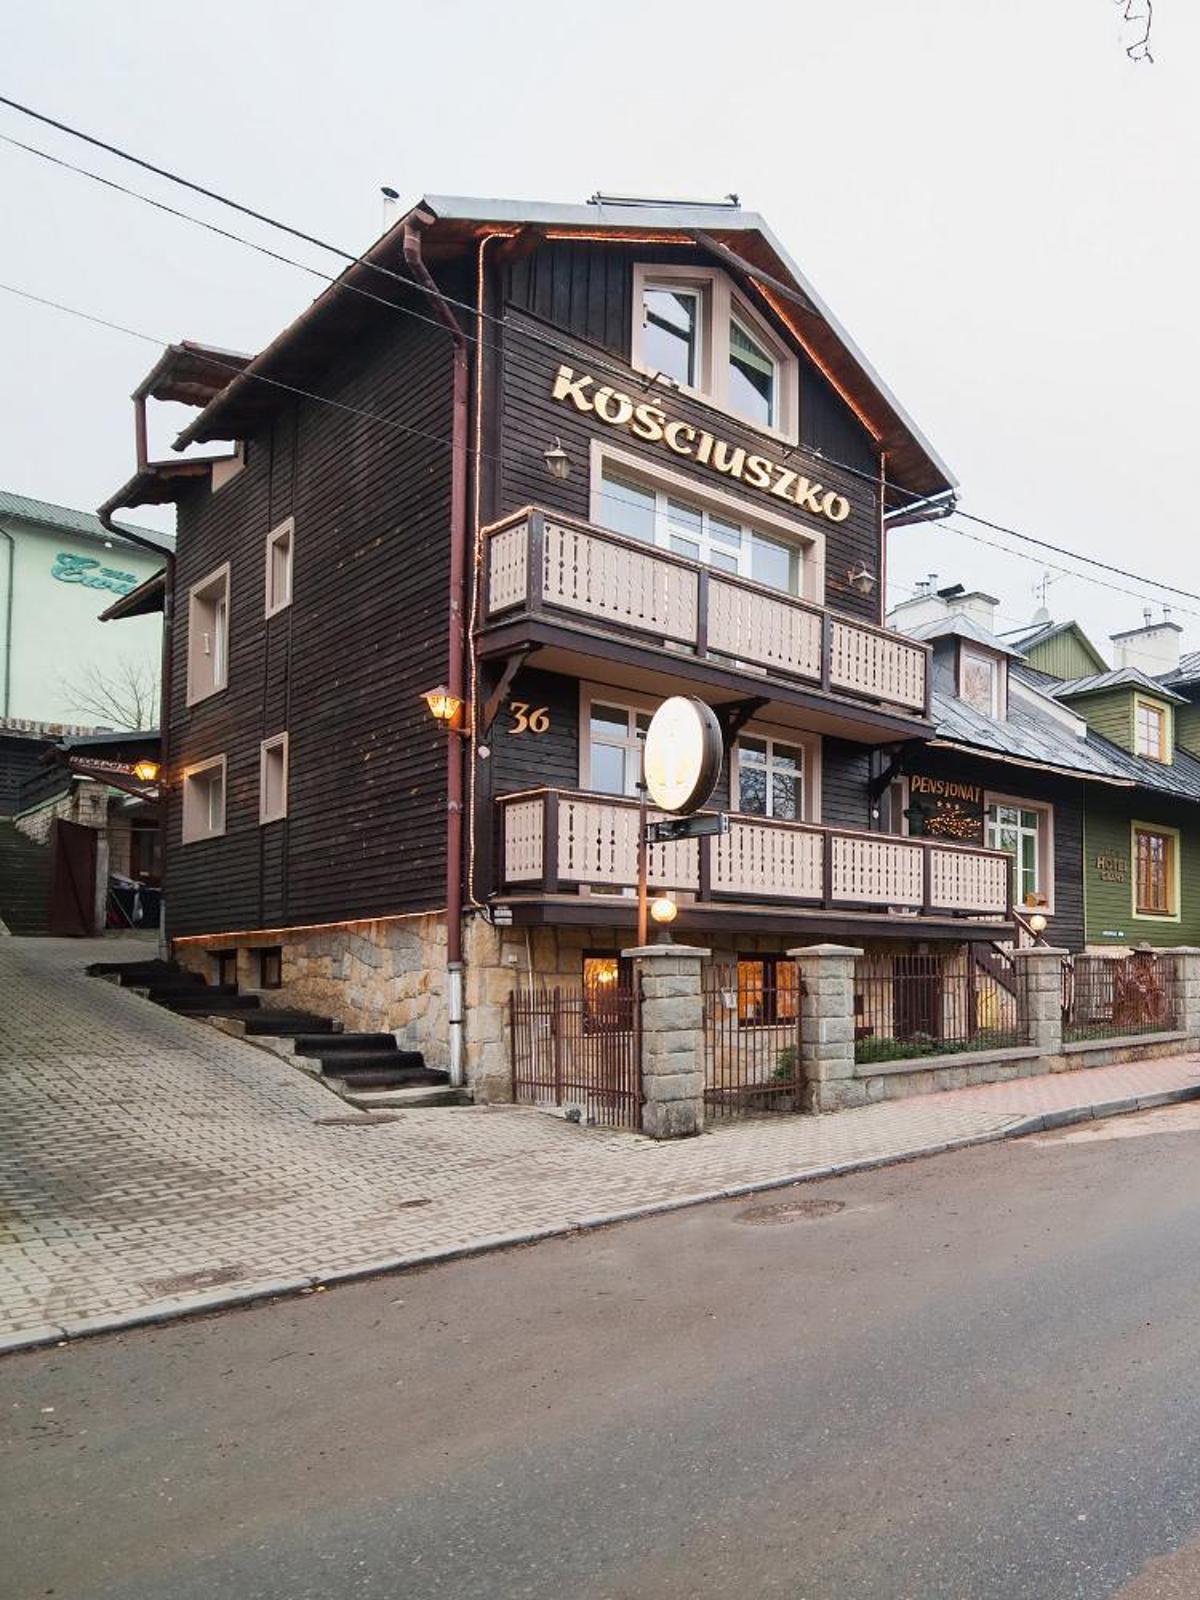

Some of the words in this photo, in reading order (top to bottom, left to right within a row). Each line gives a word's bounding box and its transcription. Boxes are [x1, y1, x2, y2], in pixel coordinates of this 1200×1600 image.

[551, 364, 851, 523] KOŚCIUSZKO
[508, 702, 550, 734] 36
[911, 775, 981, 803] PENSJONAT
[1096, 855, 1127, 873] HOTEL
